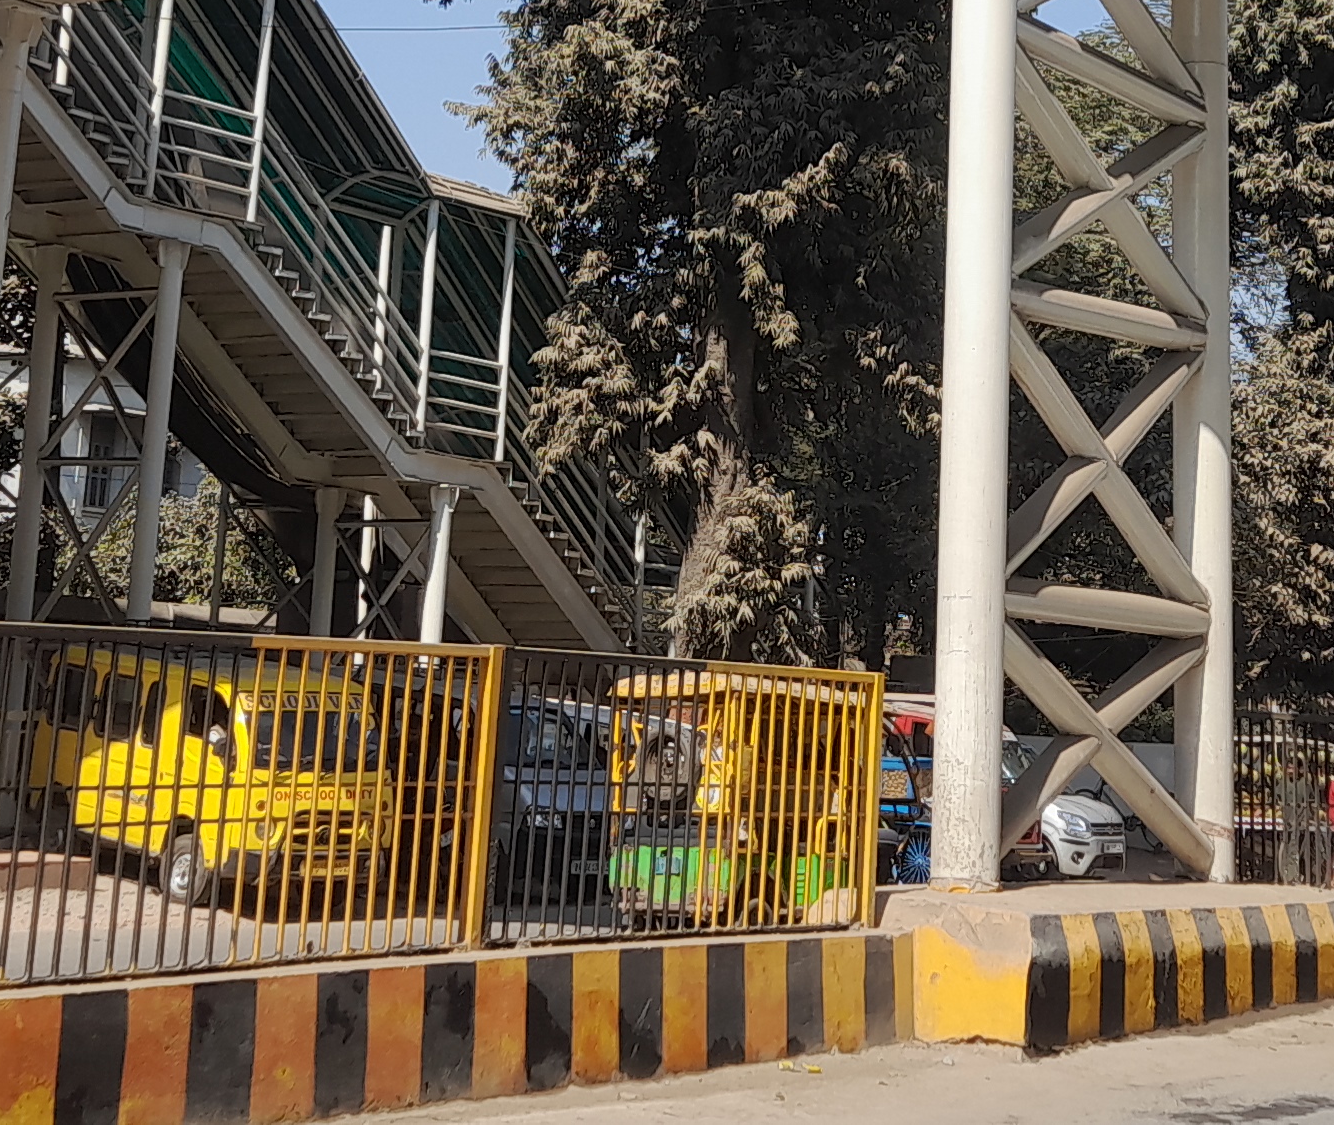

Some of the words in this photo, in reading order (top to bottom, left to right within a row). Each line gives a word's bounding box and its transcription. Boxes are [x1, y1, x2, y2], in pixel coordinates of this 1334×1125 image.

[275, 790, 291, 802] ON
[296, 789, 342, 801] SCOO
[345, 788, 373, 800] DTY
